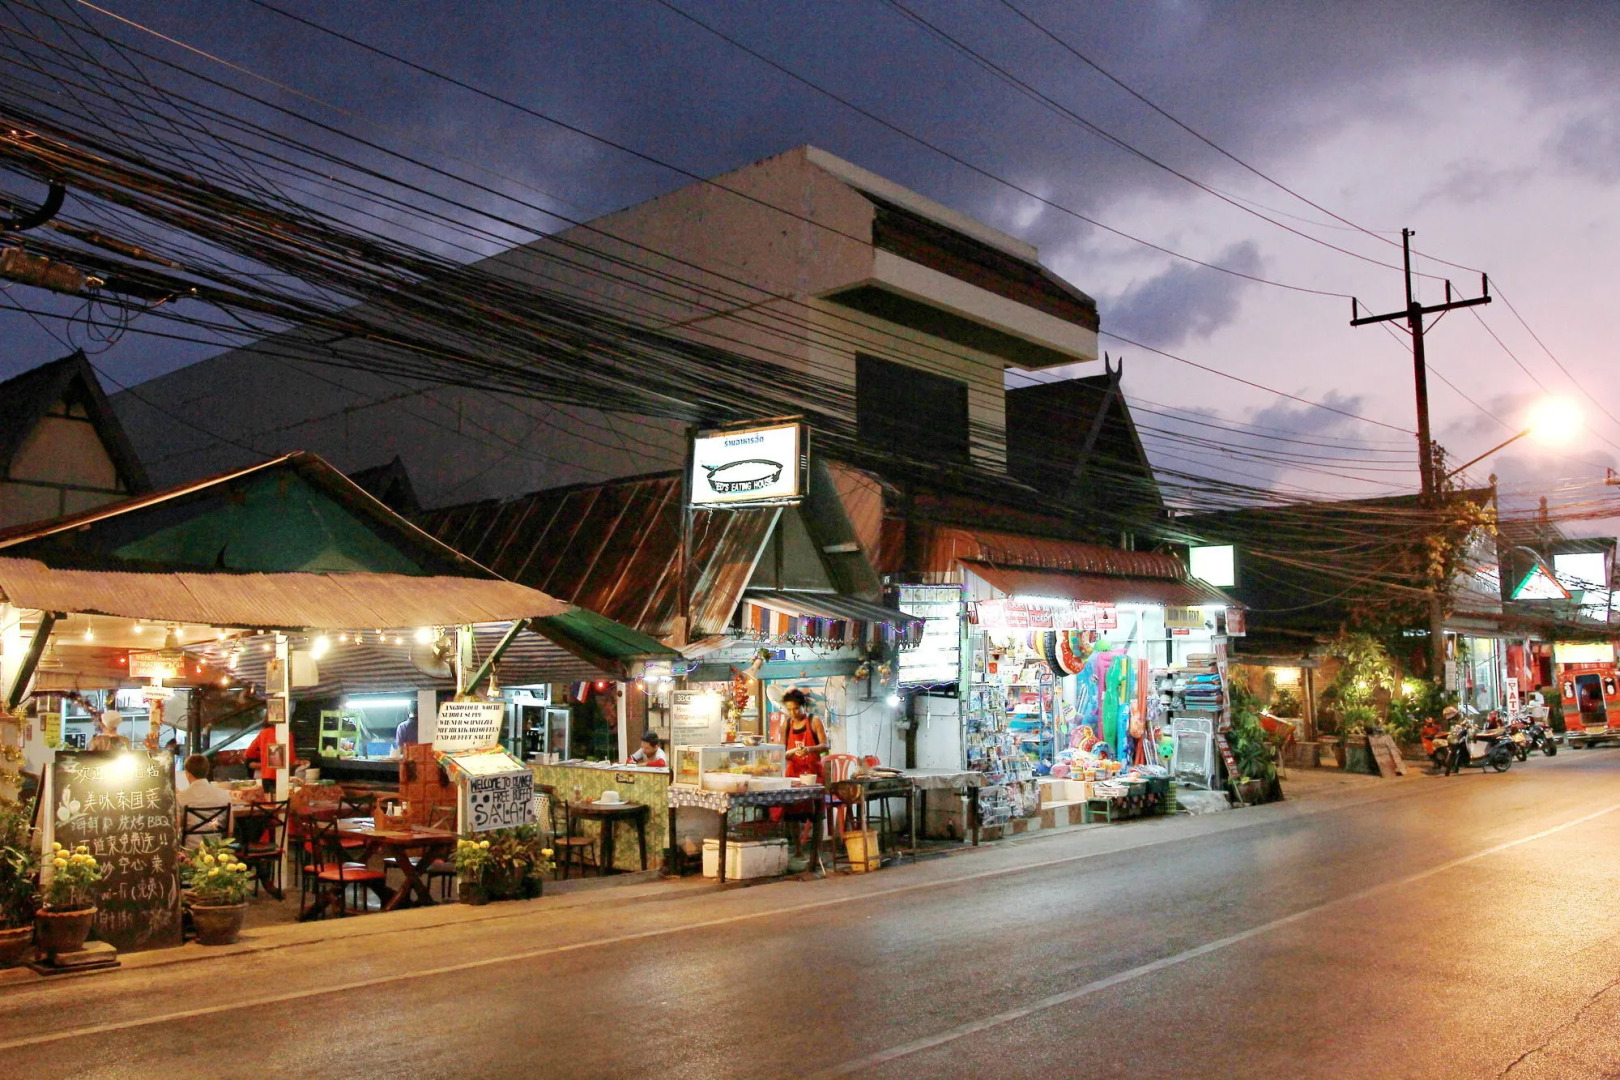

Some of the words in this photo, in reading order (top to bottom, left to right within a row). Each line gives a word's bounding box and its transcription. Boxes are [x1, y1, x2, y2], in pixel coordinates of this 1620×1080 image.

[731, 481, 752, 492] EATING
[753, 478, 773, 490] HOUSE
[470, 777, 501, 792] WELCOME
[502, 776, 511, 788] TO
[492, 790, 510, 803] FREE
[475, 800, 530, 826] SALAT
